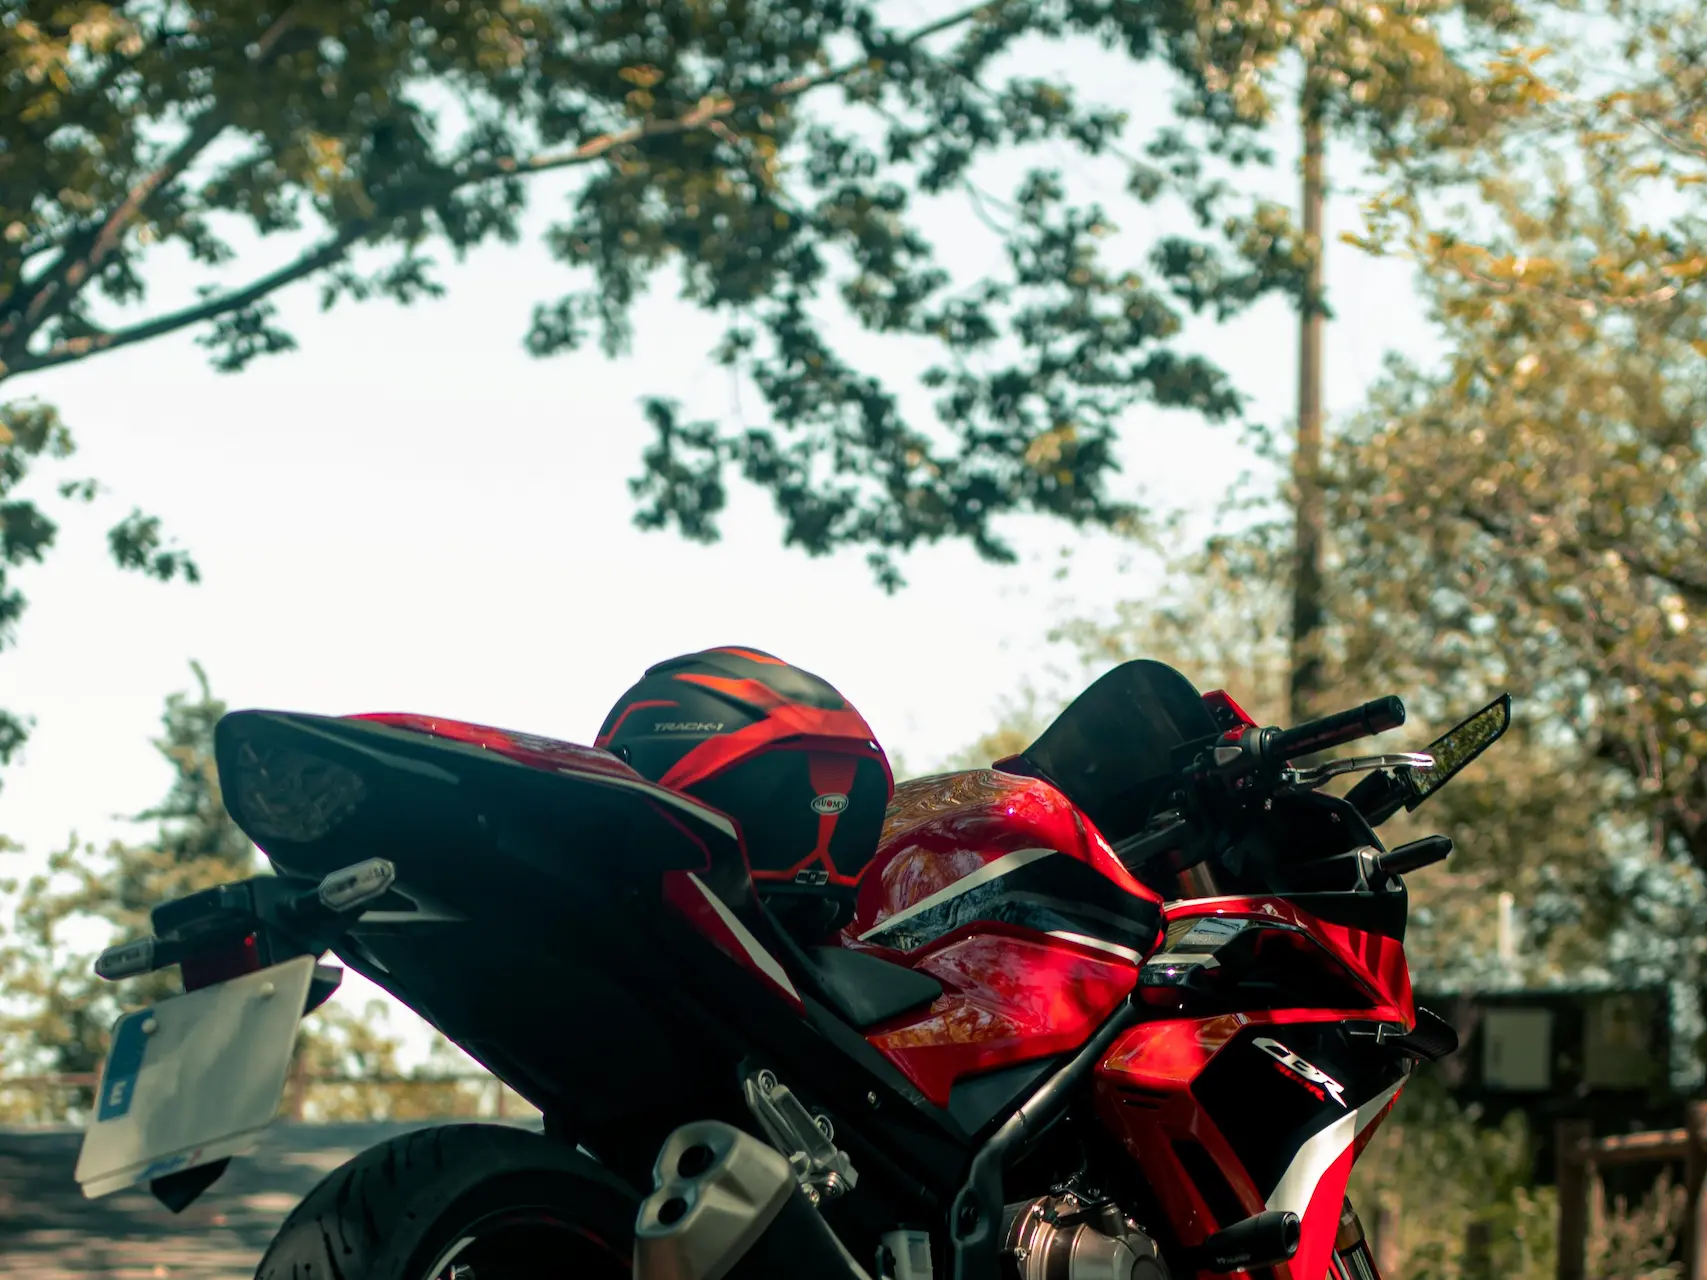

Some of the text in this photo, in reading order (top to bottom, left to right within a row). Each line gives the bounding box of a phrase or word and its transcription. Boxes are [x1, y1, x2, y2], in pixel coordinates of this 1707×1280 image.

[654, 722, 724, 732] TRACK-1
[814, 797, 847, 809] SUOMY
[1252, 1037, 1347, 1108] CBR
